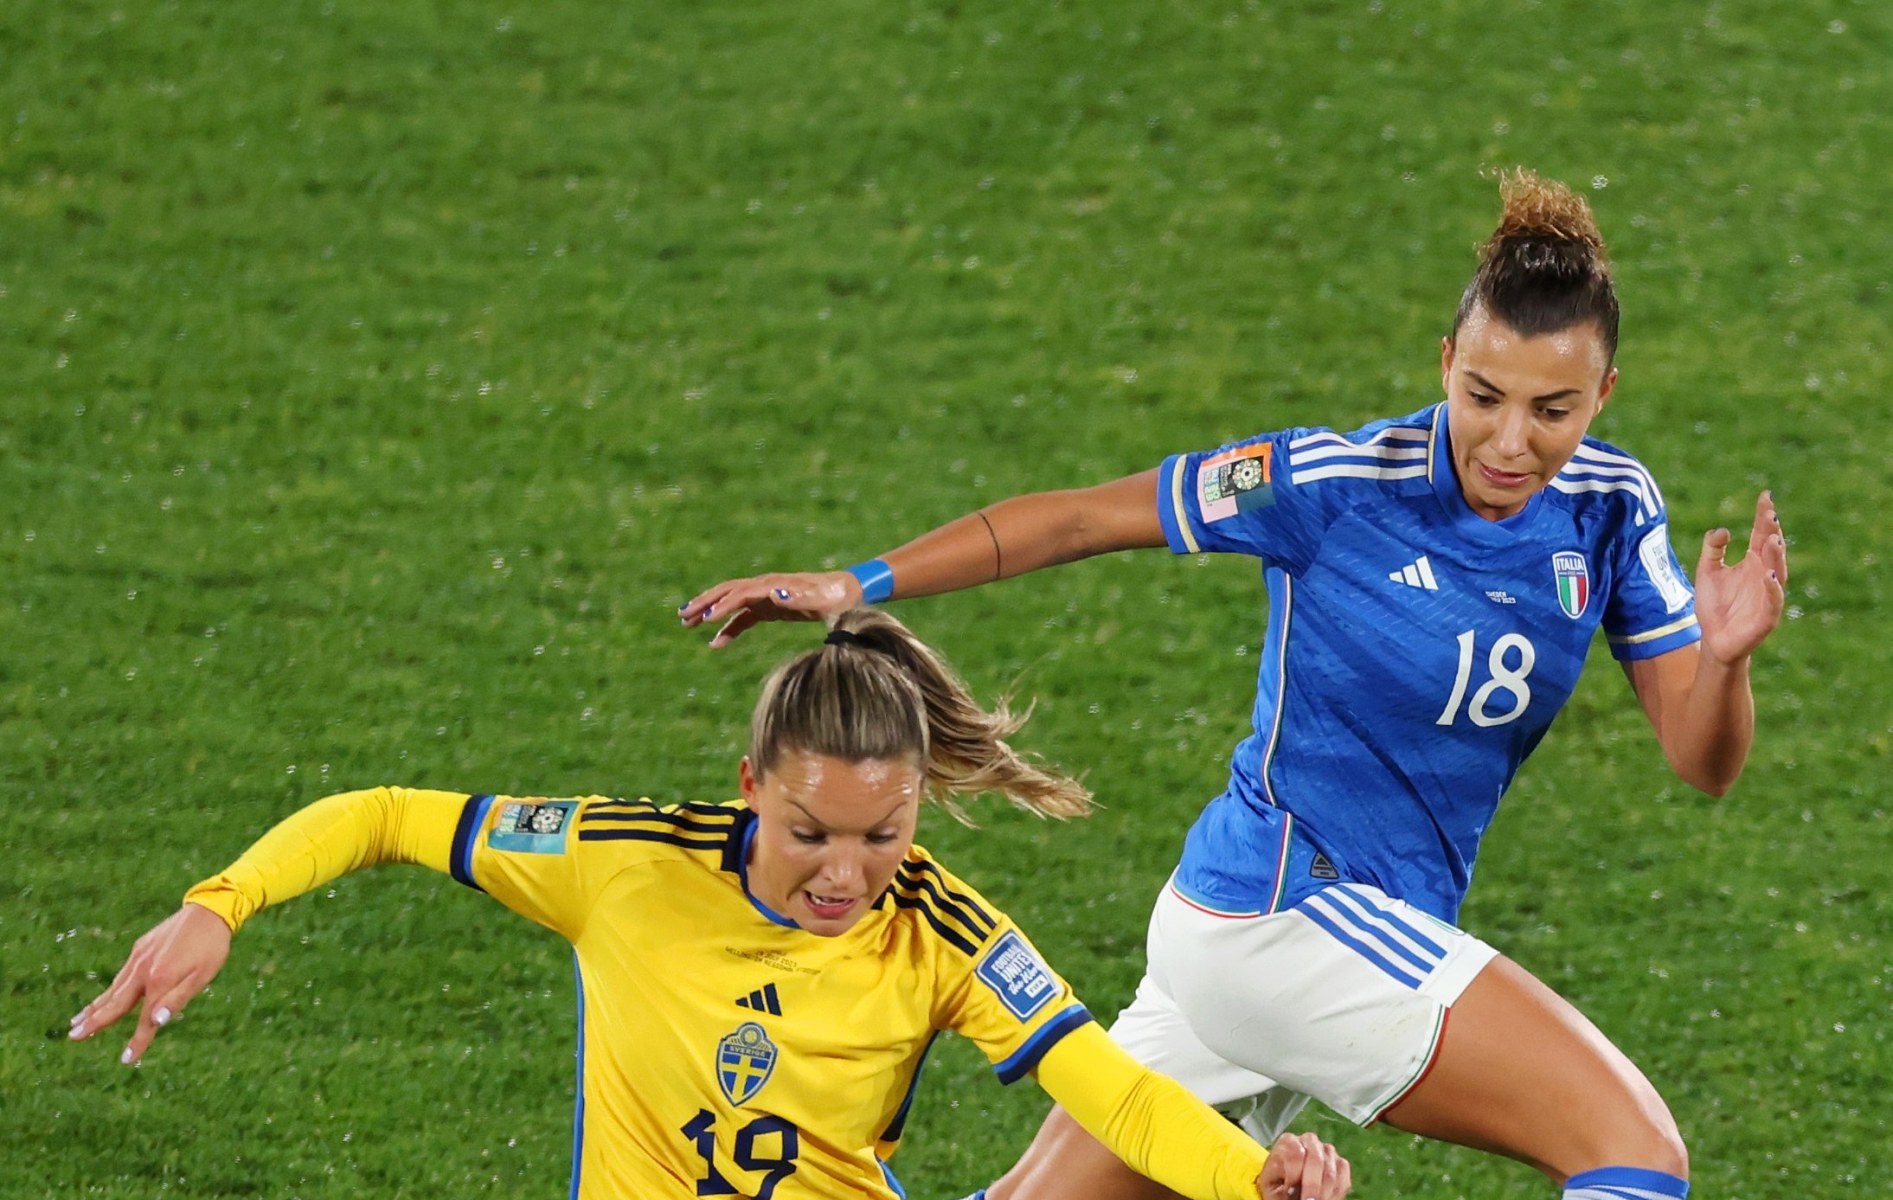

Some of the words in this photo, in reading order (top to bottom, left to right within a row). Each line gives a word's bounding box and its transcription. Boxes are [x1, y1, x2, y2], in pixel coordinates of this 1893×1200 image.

[1556, 558, 1584, 571] ITALIA
[1435, 629, 1535, 728] 18
[1028, 979, 1045, 995] FIFA
